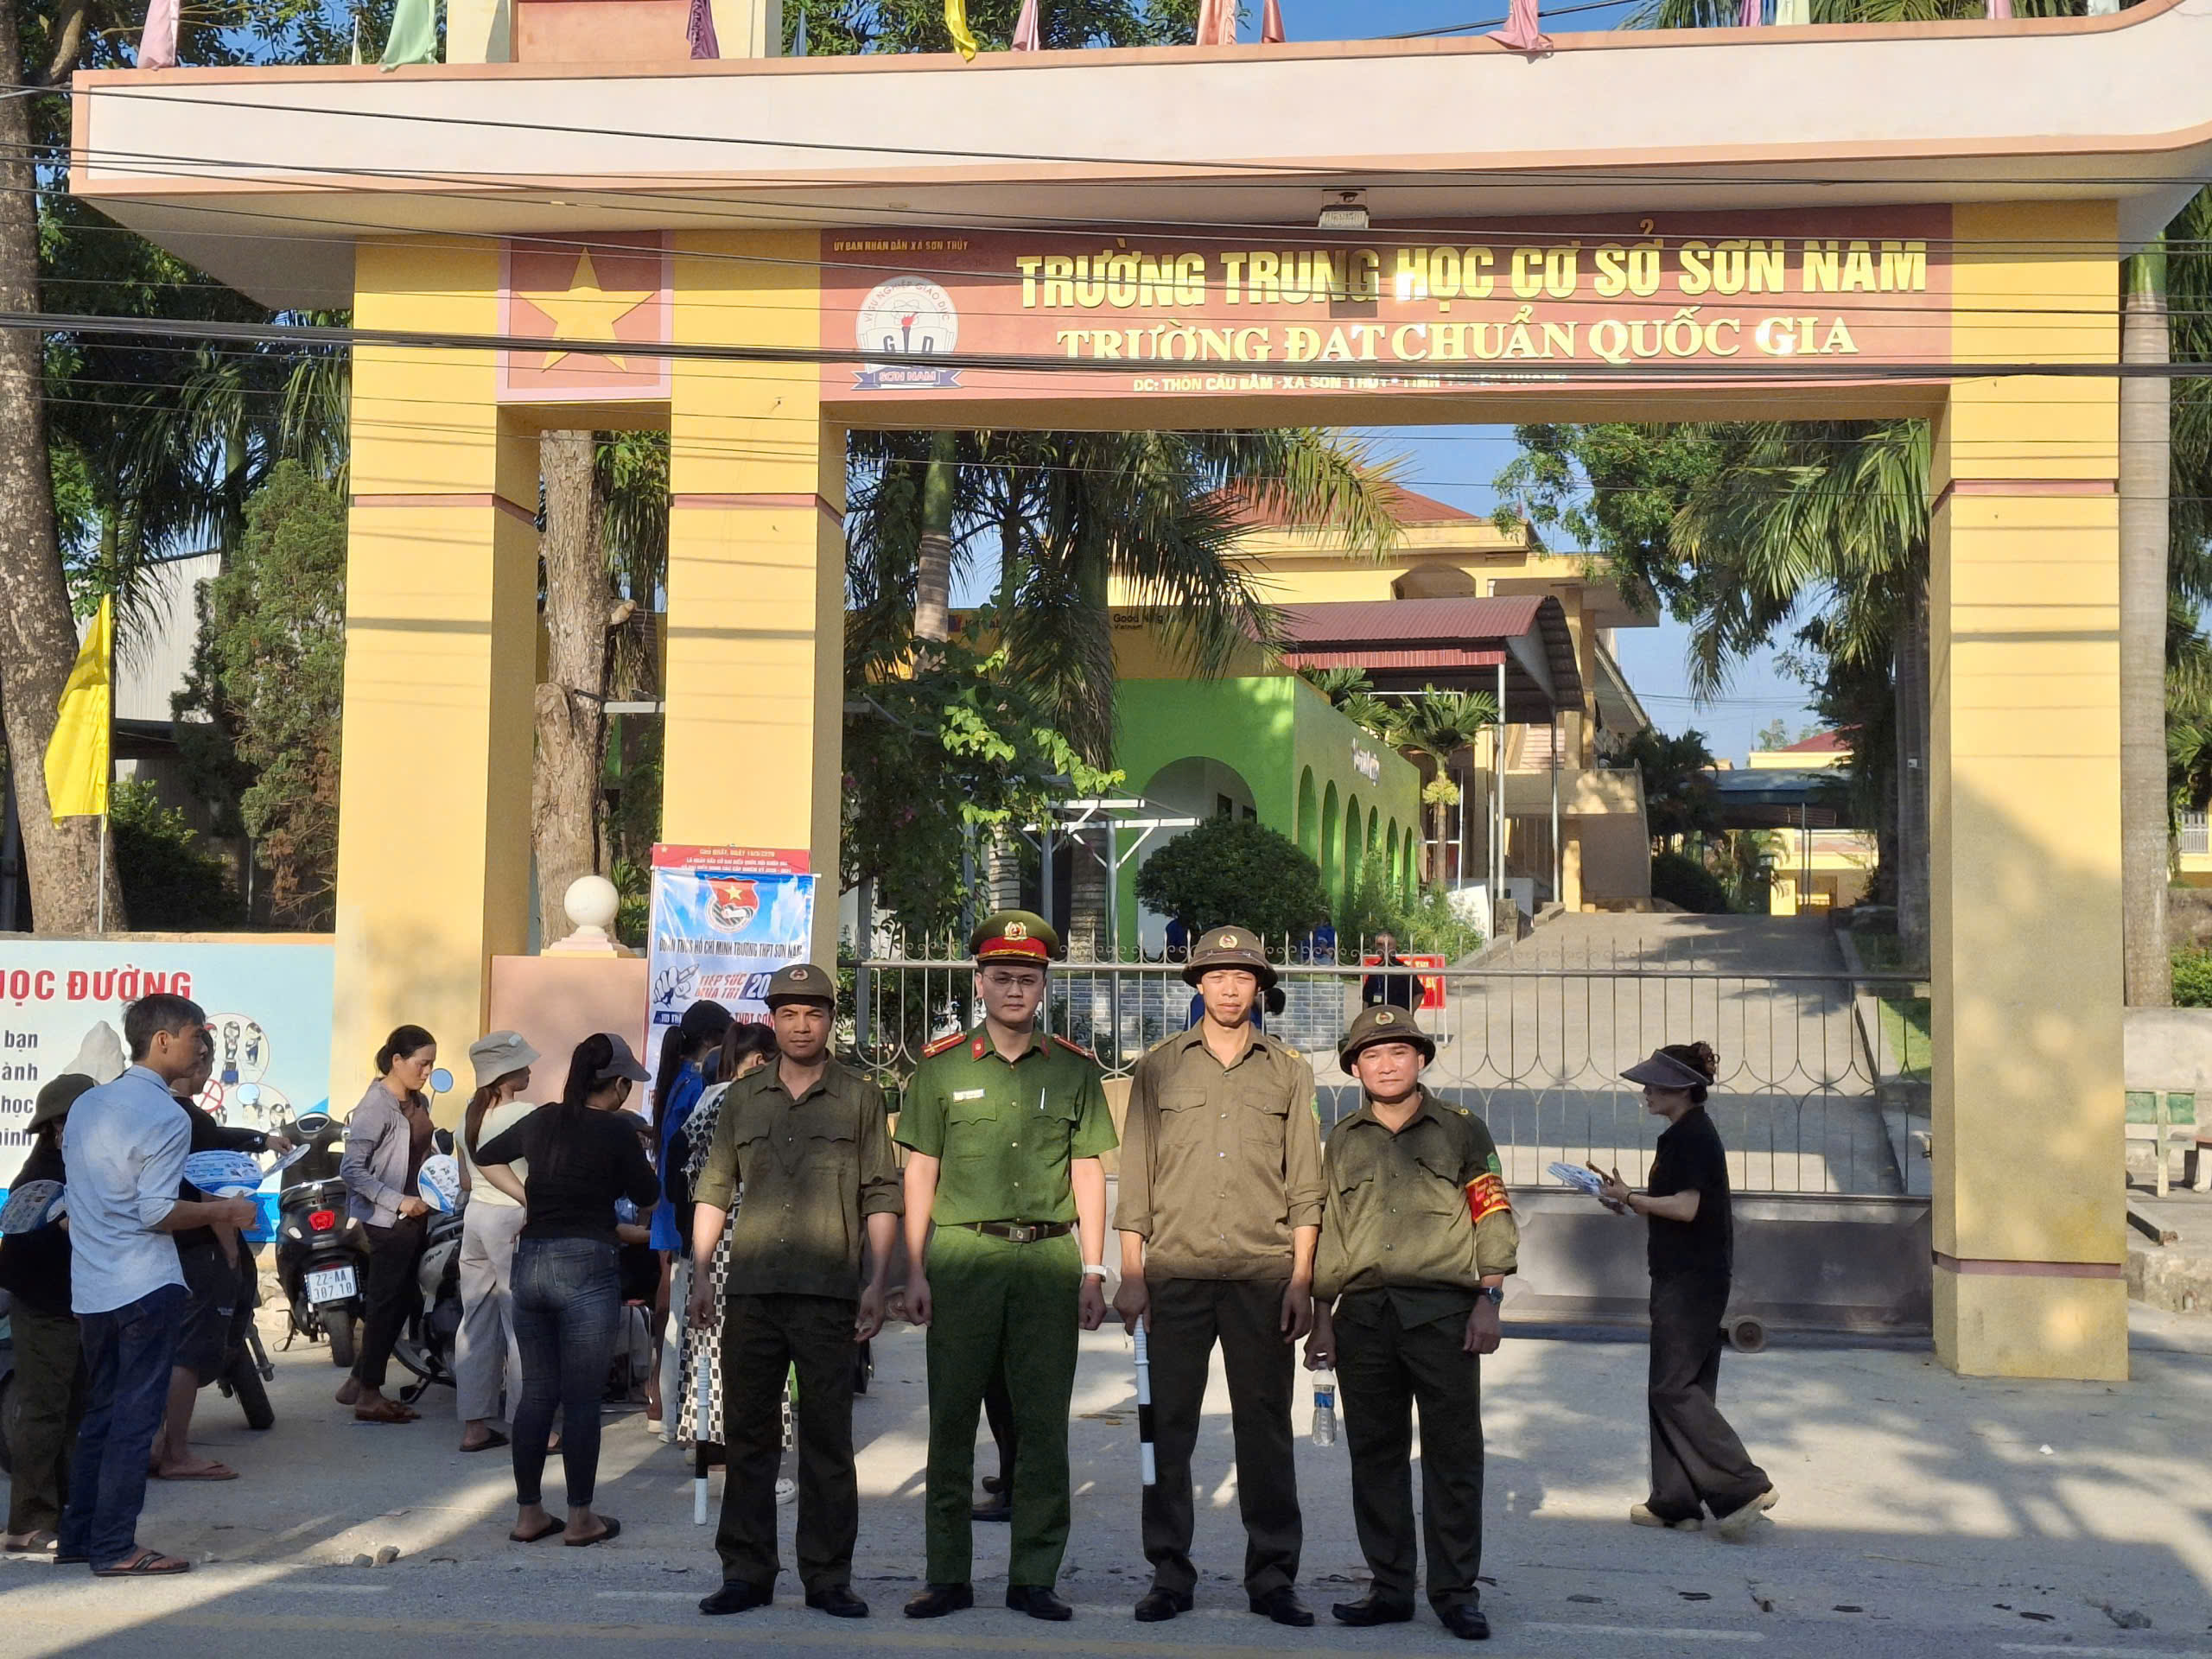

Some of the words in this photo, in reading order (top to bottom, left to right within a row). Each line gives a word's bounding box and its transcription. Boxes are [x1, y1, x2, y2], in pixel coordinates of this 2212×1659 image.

[845, 241, 863, 251] BAN
[925, 240, 944, 251] SƠN
[1016, 237, 1206, 308] TRƯỜNG
[1220, 248, 1380, 304] TRUNG
[1395, 245, 1495, 312] HỌC
[1511, 240, 1582, 299] CƠ
[1593, 219, 1665, 298] SỞ
[1678, 239, 1785, 296] SƠN
[1802, 239, 1927, 294] NAM
[1056, 316, 1273, 362] TRƯỜNG
[1391, 304, 1580, 361] CHUẨN
[1588, 302, 1741, 365] QUỐC
[1755, 316, 1860, 355] GIA
[760, 942, 773, 958] THPT
[0, 969, 55, 1007] ỌC
[67, 964, 192, 1001] ĐƯỜNG
[4, 1029, 38, 1052] bạn
[1, 1095, 35, 1117] học
[315, 1270, 347, 1287] 22-AA
